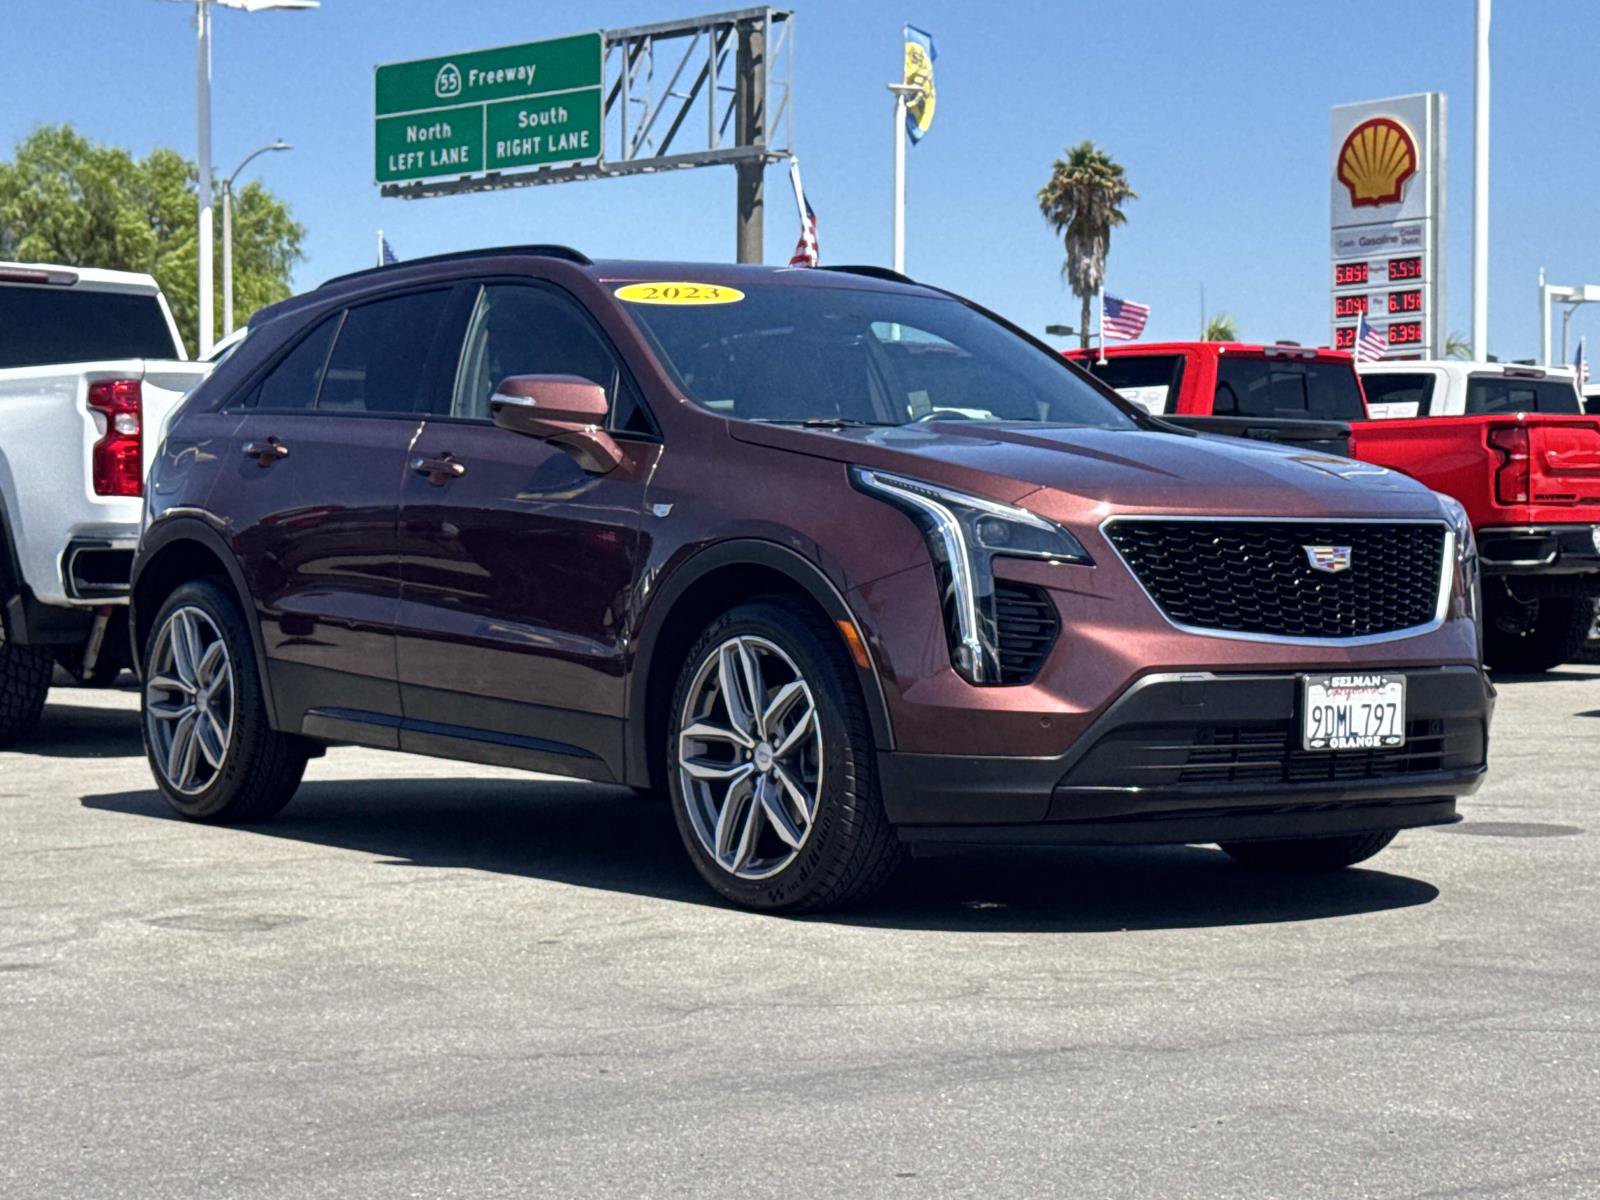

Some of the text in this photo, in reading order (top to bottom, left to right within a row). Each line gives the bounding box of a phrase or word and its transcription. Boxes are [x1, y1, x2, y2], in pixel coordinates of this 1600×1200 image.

[440, 64, 536, 91] 55 Freeway
[518, 107, 568, 128] South
[406, 122, 451, 143] North
[496, 130, 589, 158] RIGHT LANE
[389, 146, 469, 171] LEFT LANE
[1359, 235, 1399, 246] Gasoline
[642, 287, 720, 300] 2023
[1332, 676, 1381, 687] SELMAN
[1312, 703, 1397, 739] 9DML797
[1329, 736, 1381, 748] ORANGE
